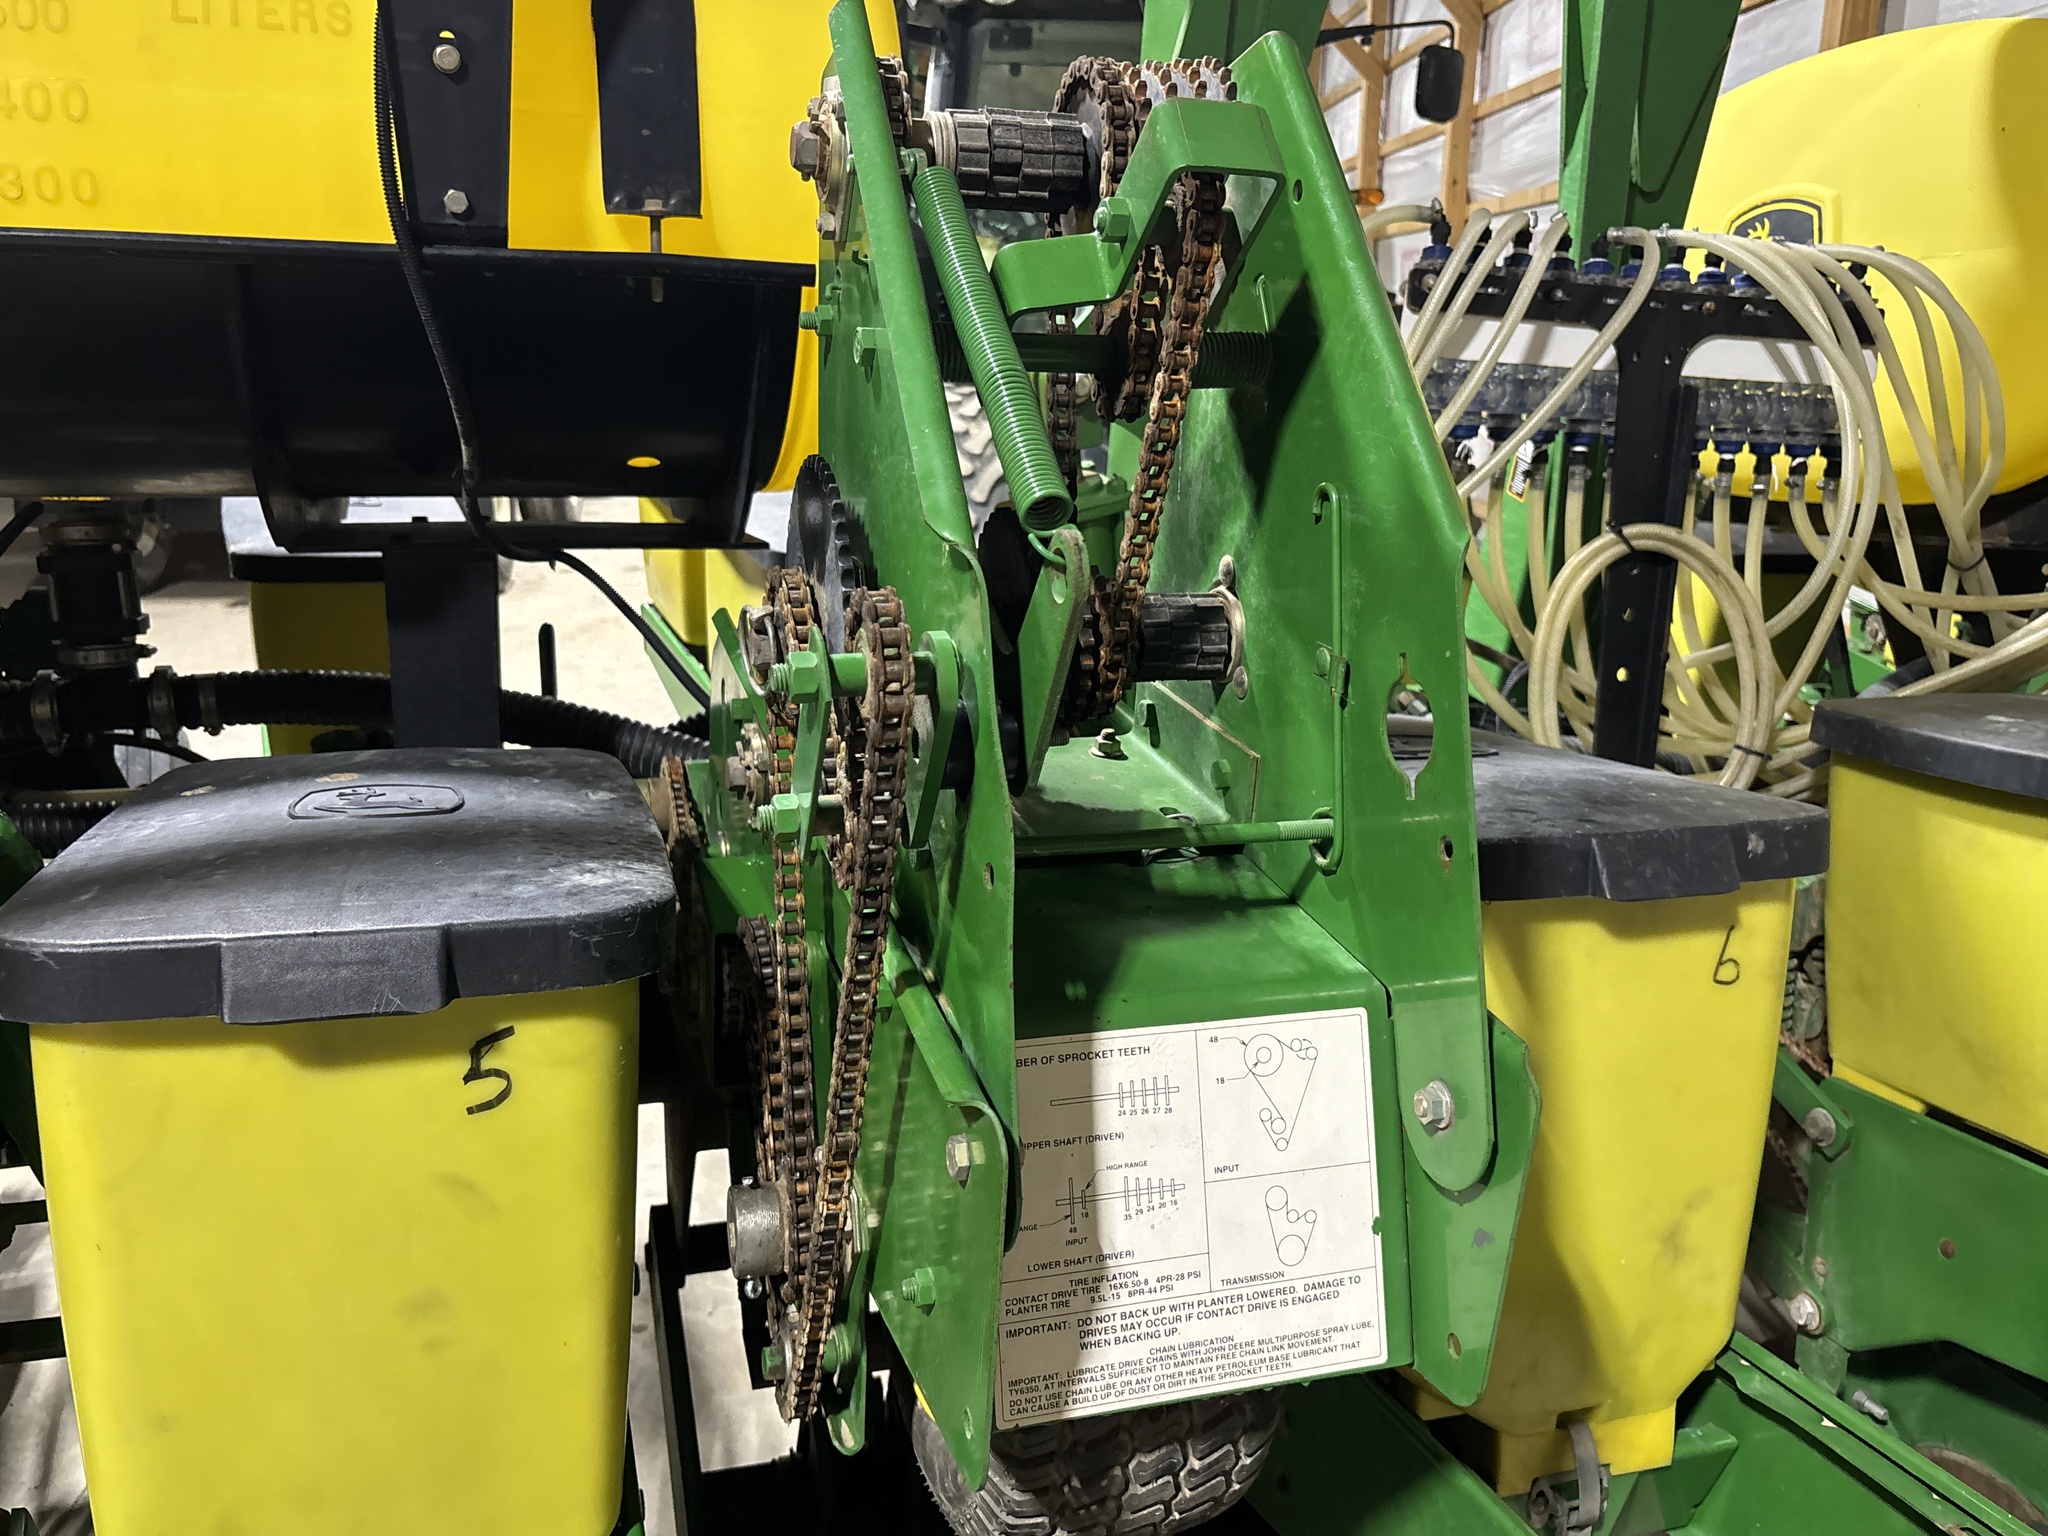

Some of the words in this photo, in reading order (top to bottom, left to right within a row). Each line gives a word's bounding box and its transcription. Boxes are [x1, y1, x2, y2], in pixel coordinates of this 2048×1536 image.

[0, 0, 69, 34] 00
[170, 0, 353, 37] LITERS
[1713, 925, 1740, 986] 6
[463, 1025, 515, 1115] 5
[1016, 1057, 1037, 1068] BER
[1041, 1056, 1055, 1064] OF
[1058, 1050, 1114, 1063] SPROCKET
[1118, 1046, 1150, 1057] TEETH
[1054, 1136, 1082, 1147] SHAFT
[1085, 1132, 1124, 1144] (DRIVEN)
[1124, 1160, 1147, 1168] RANGE
[1214, 1164, 1239, 1174] INPUT
[1019, 1224, 1038, 1232] ANGE
[1066, 1238, 1088, 1246] INPUT
[1028, 1260, 1061, 1272] LOWER
[1064, 1256, 1093, 1267] SHAFT
[1096, 1251, 1134, 1264] (DRIVER)
[1005, 1294, 1049, 1307] CONTACT
[1052, 1290, 1078, 1300] DRIVE
[1082, 1286, 1101, 1295] TIRE
[1109, 1279, 1148, 1291] 16X6.50-8
[1156, 1274, 1185, 1284] 4PR-28
[1188, 1271, 1201, 1279] PSI
[1069, 1278, 1089, 1287] TIRE
[1092, 1271, 1138, 1284] INFLATION
[1221, 1271, 1285, 1286] TRANSMISSION
[1006, 1304, 1048, 1316] PLANTER
[1050, 1300, 1070, 1309] TIRE
[1091, 1293, 1120, 1304] 9.5L-15
[1128, 1287, 1157, 1298] 8PR-44
[1160, 1285, 1173, 1293] PSI
[1006, 1321, 1071, 1338] IMPORTANT:
[1078, 1317, 1092, 1327] DO
[1096, 1313, 1117, 1324] NOT
[1120, 1309, 1149, 1320] BACK
[1152, 1306, 1166, 1315] UP
[1169, 1301, 1194, 1313] WITH
[1198, 1294, 1244, 1308] PLANTER
[1246, 1286, 1299, 1301] LOWERED.
[1303, 1278, 1345, 1292] DAMAGE
[1348, 1275, 1361, 1285] TO
[1079, 1325, 1117, 1339] DRIVES
[1120, 1321, 1143, 1332] MAY
[1146, 1315, 1182, 1328] OCCUR
[1185, 1313, 1194, 1322] IF
[1197, 1306, 1245, 1320] CONTACT
[1248, 1301, 1277, 1313] DRIVE
[1280, 1298, 1289, 1307] IS
[1291, 1290, 1340, 1305] ENGAGED
[1079, 1338, 1111, 1351] WHEN
[1114, 1329, 1161, 1345] BACKING
[1164, 1327, 1180, 1338] UP.
[1150, 1346, 1175, 1355] CHAIN
[1178, 1335, 1234, 1352] LUBRICATION
[1009, 1372, 1062, 1388] IMPORTANT:
[1067, 1363, 1116, 1378] LUBRICATE
[1119, 1359, 1144, 1369] DRIVE
[1147, 1353, 1178, 1364] CHAINS
[1181, 1349, 1200, 1359] WITH
[1203, 1345, 1225, 1357] JOHN
[1228, 1341, 1255, 1352] DEERE
[1258, 1329, 1321, 1346] MULTIPURPOSE
[1323, 1323, 1349, 1335] SPRAY
[1044, 1382, 1055, 1390] AT
[1058, 1374, 1106, 1388] INTERVALS
[1108, 1365, 1157, 1379] SUFFICIENT
[1160, 1362, 1171, 1370] TO
[1174, 1353, 1213, 1369] MAINTAIN
[1215, 1353, 1237, 1363] FREE
[1239, 1347, 1265, 1358] CHAIN
[1266, 1343, 1285, 1353] LINK
[1287, 1335, 1335, 1349] MOVEMENT.
[1009, 1399, 1022, 1408] DO
[1025, 1396, 1042, 1405] NOT
[1045, 1393, 1063, 1401] USE
[1065, 1388, 1092, 1399] CHAIN
[1095, 1382, 1117, 1393] LUBE
[1120, 1379, 1132, 1388] OR
[1135, 1376, 1152, 1386] ANY
[1155, 1370, 1183, 1382] OTHER
[1186, 1367, 1213, 1378] HEAVY
[1216, 1358, 1266, 1372] PETROLEUM
[1269, 1353, 1291, 1363] BASE
[1293, 1345, 1338, 1359] LUBRICANT
[1340, 1341, 1361, 1350] THAT
[1009, 1407, 1028, 1416] CAN
[1031, 1401, 1061, 1412] CAUSE
[1072, 1393, 1098, 1405] BUILD
[1100, 1391, 1111, 1400] UP
[1114, 1389, 1125, 1397] OF
[1128, 1384, 1151, 1395] DUST
[1154, 1382, 1165, 1391] OR
[1168, 1379, 1186, 1388] DIRT
[1189, 1376, 1198, 1385] IN
[1200, 1373, 1216, 1382] THE
[1219, 1367, 1263, 1380] SPROCKET
[1265, 1362, 1293, 1372] TEETH.
